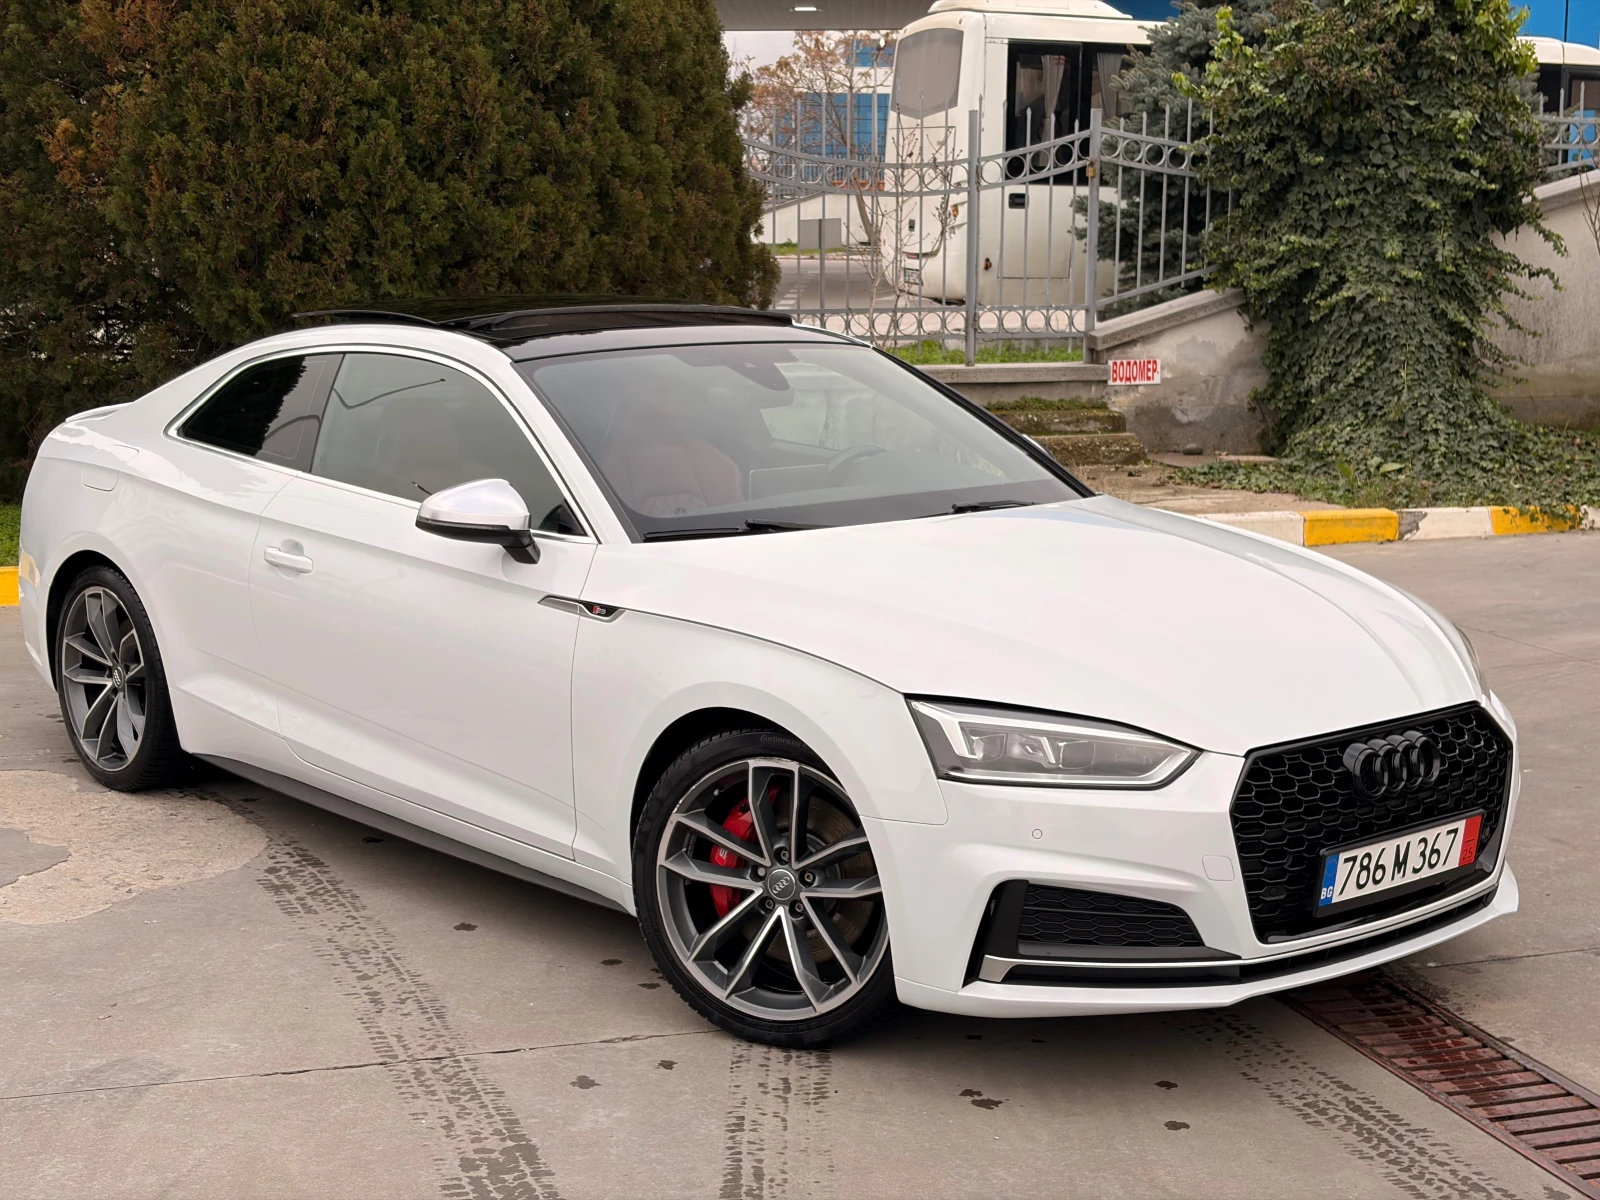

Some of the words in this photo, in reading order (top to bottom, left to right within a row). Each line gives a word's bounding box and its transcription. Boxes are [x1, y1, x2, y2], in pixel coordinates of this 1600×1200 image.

[1111, 359, 1158, 384] ВОДОМЕР
[1338, 848, 1386, 896] 786
[1390, 840, 1411, 882] M
[1412, 827, 1460, 874] 367
[1462, 847, 1474, 860] 25
[1320, 887, 1333, 900] BG
